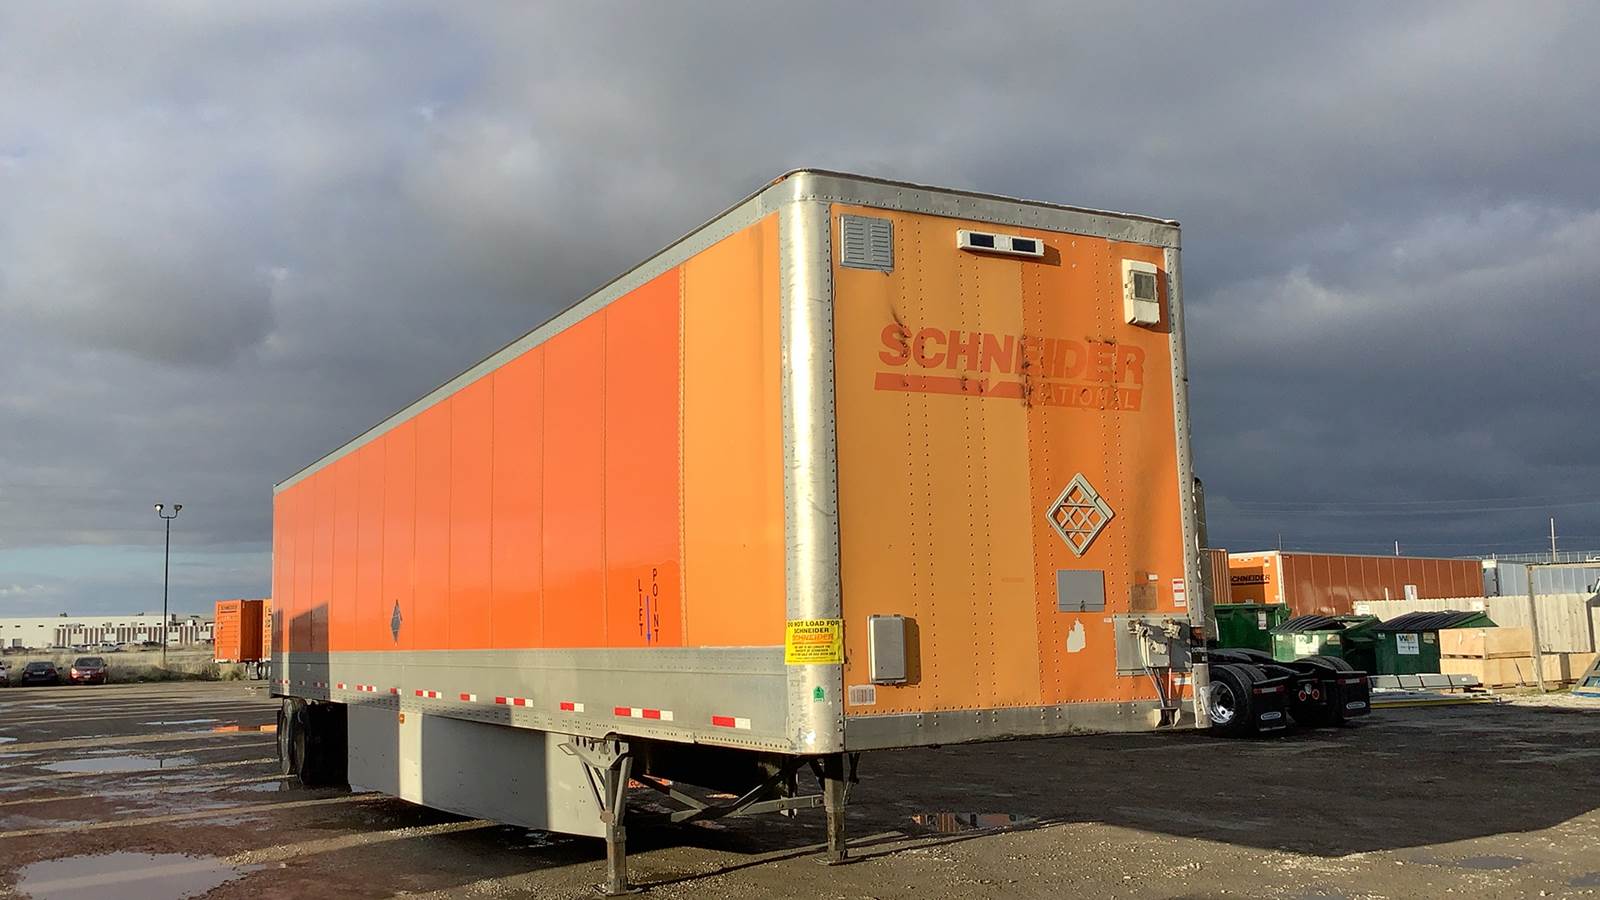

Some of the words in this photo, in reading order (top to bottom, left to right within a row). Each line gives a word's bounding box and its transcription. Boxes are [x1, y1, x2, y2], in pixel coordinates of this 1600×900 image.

[878, 323, 1146, 386] SCHNEIDER
[1027, 382, 1136, 410] ATIONAL
[1230, 573, 1271, 582] CHNEIDER
